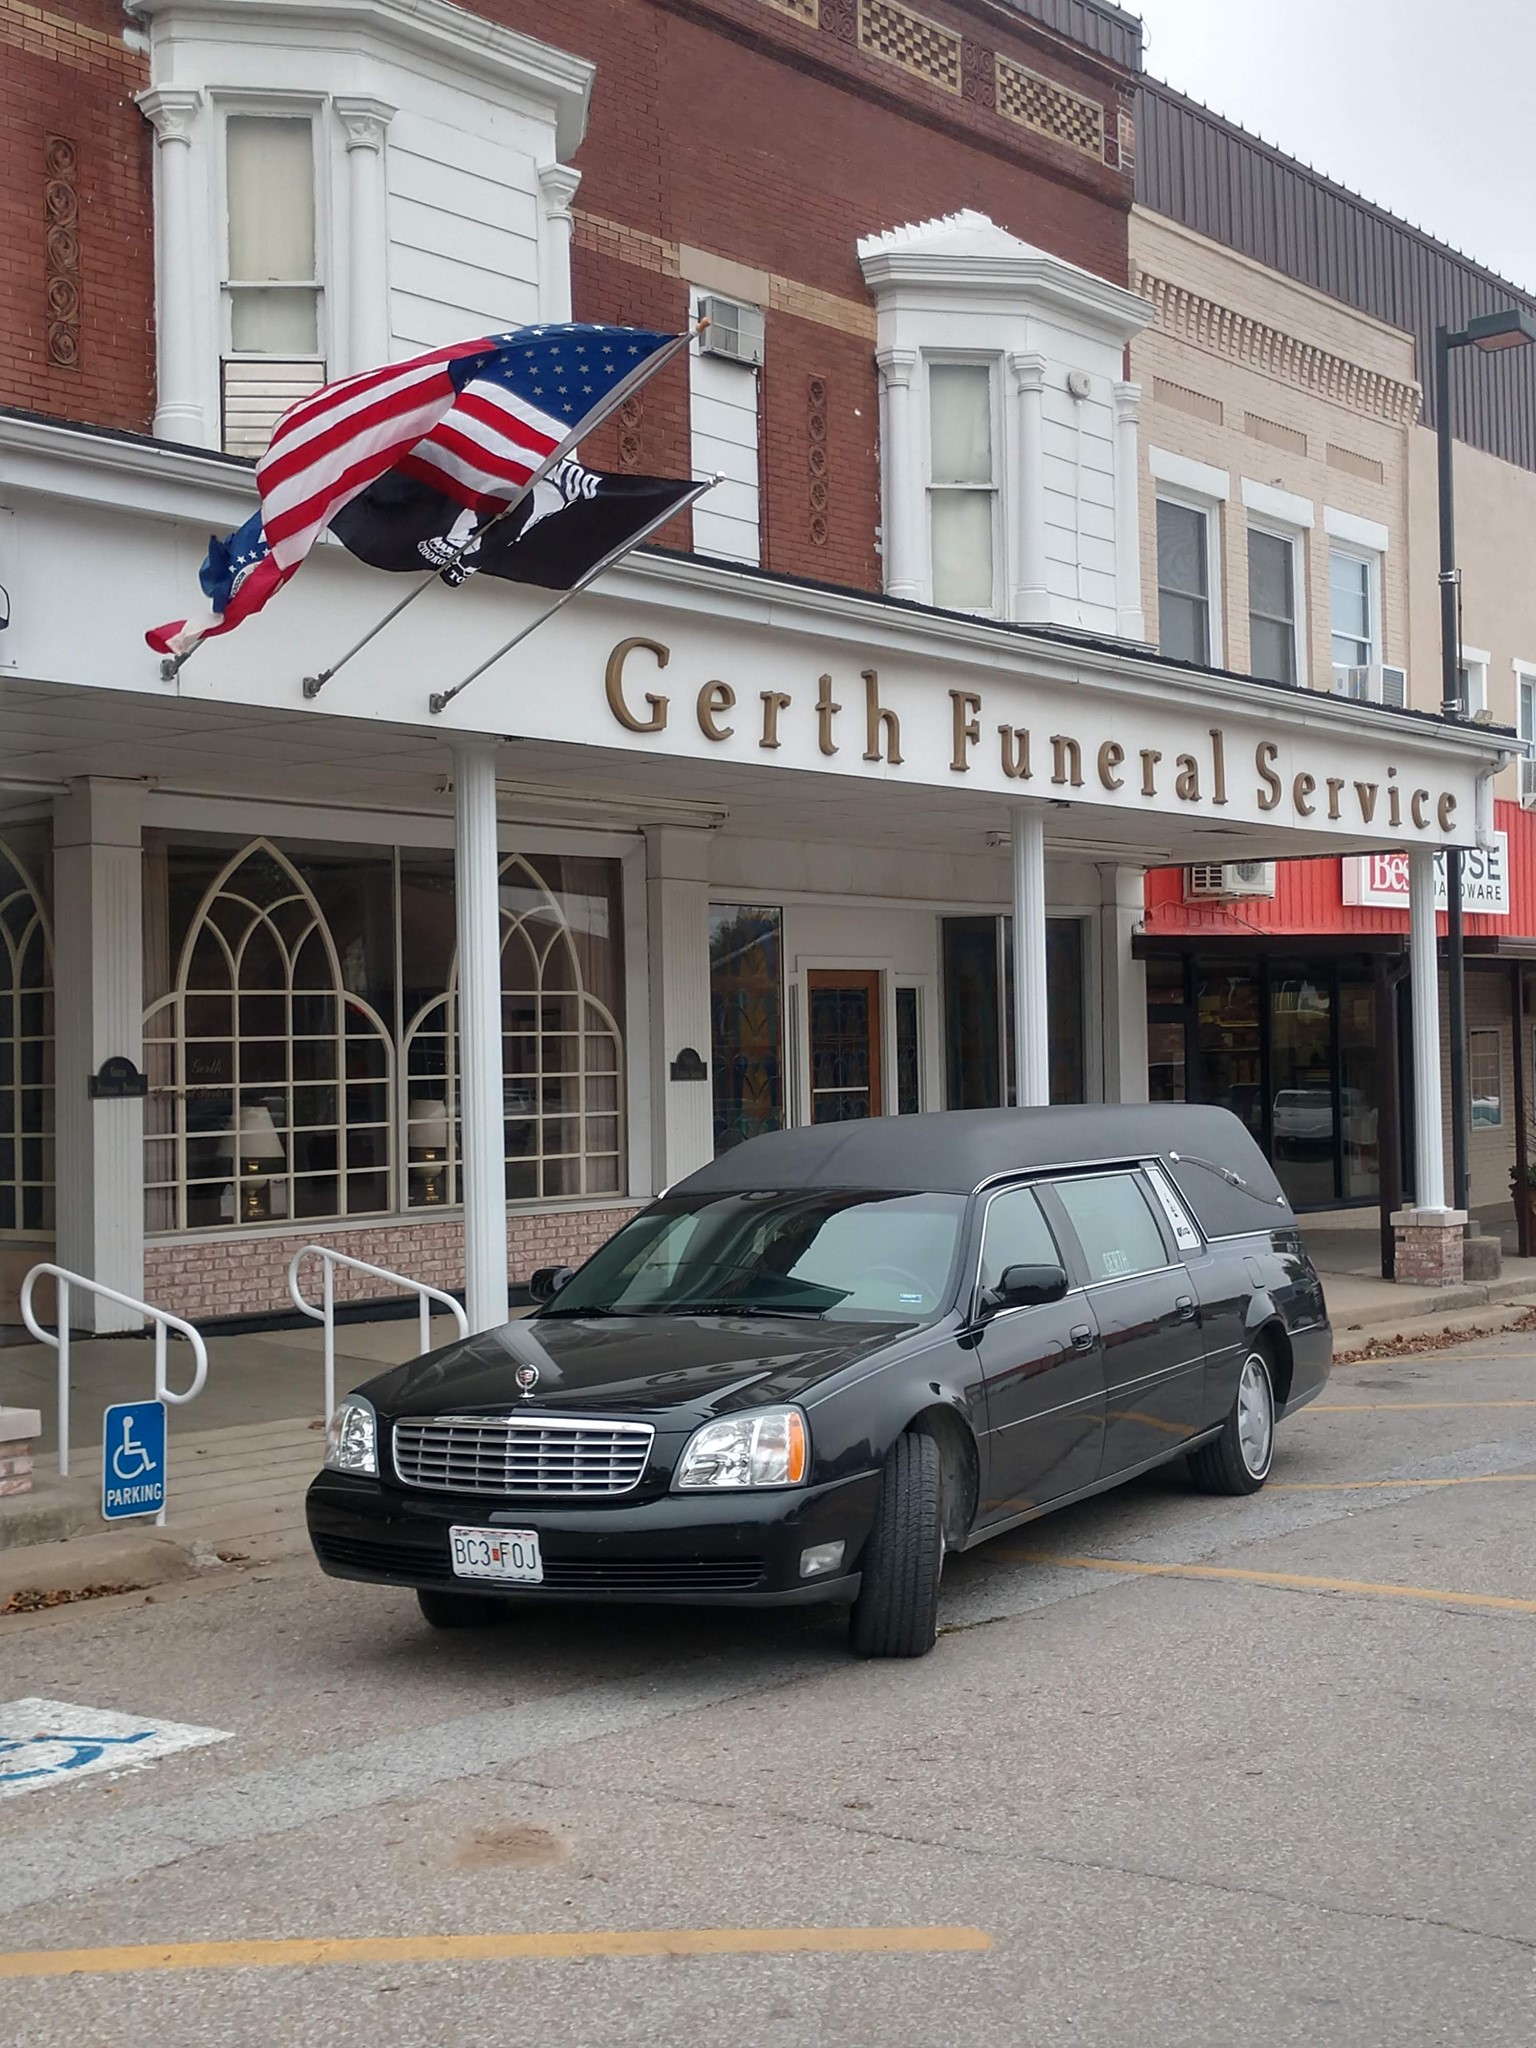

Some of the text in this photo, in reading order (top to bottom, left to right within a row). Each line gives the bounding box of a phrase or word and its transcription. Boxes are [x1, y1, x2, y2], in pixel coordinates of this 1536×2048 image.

[605, 637, 1457, 832] Gerth Funeral Service
[106, 1483, 162, 1507] PARKING
[454, 1538, 490, 1566] BC3
